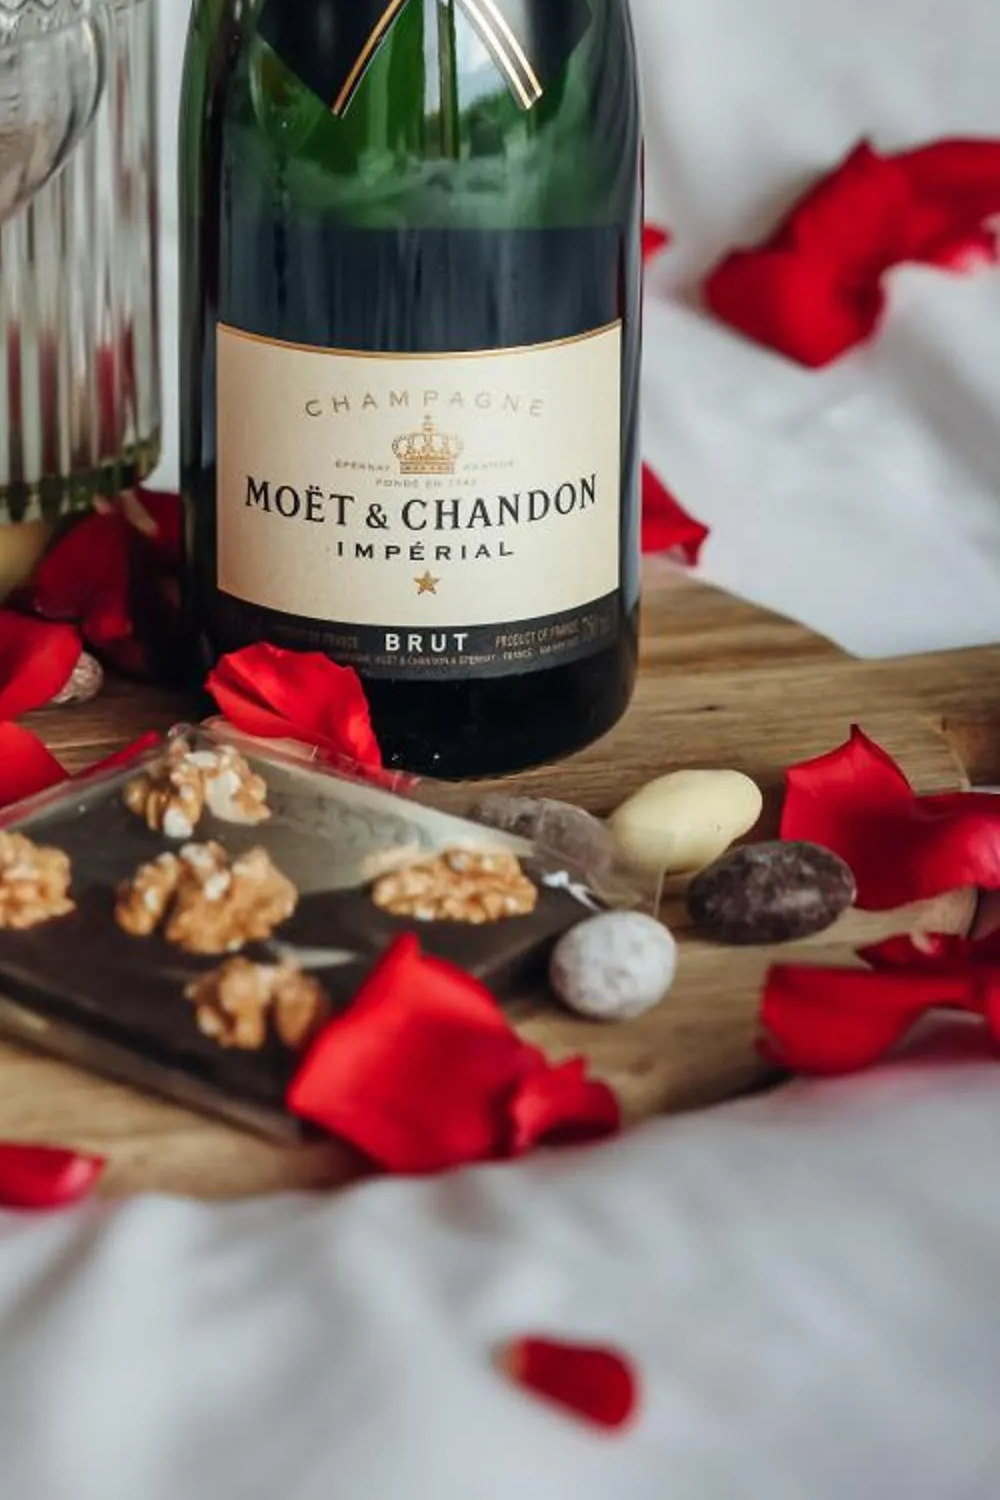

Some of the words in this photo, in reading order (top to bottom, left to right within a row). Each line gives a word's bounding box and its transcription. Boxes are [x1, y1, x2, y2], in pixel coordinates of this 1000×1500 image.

[304, 389, 546, 418] CHAMPAGNE
[244, 475, 355, 528] MOËT
[365, 503, 390, 529] &
[401, 473, 598, 531] CHANDON
[337, 540, 515, 562] IMPÉRIAL
[385, 633, 469, 652] BRUT
